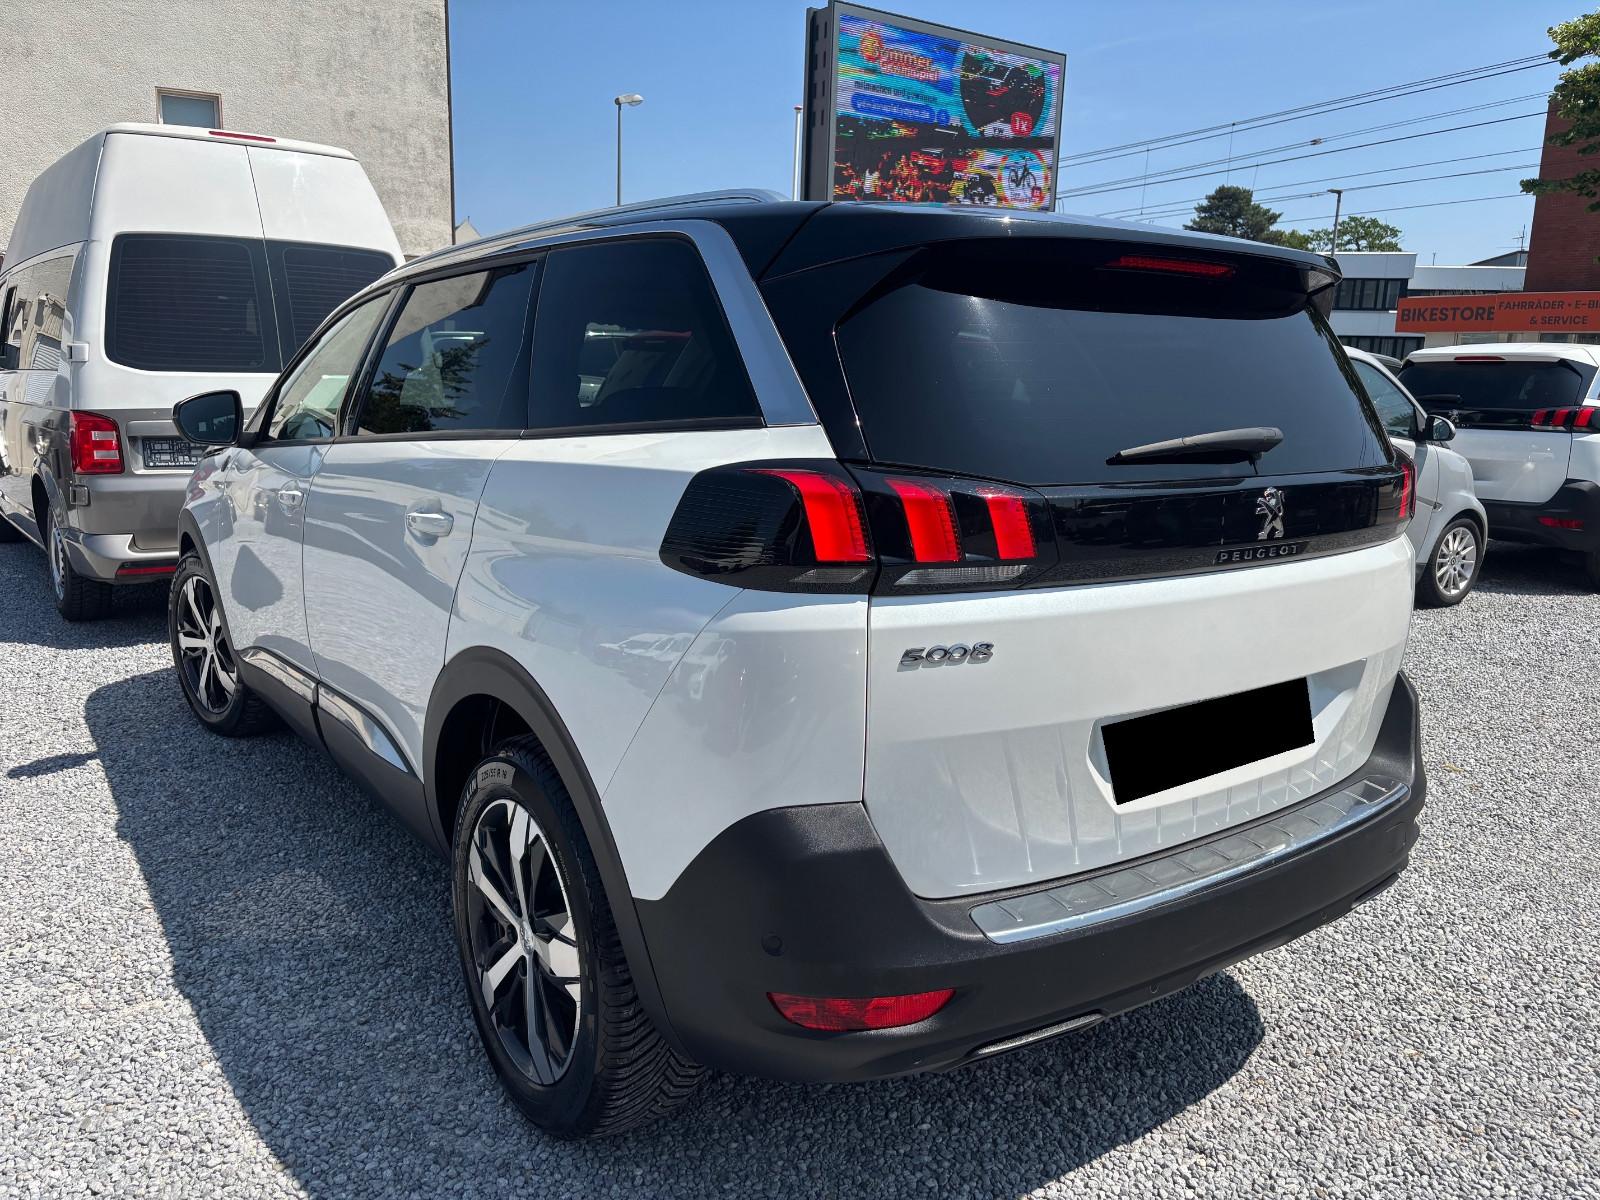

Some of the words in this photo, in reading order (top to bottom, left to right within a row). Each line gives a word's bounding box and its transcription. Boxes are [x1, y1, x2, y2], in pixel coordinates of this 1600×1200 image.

[1499, 299, 1564, 311] FAHRRÄDER
[1575, 299, 1600, 309] E-BI
[1400, 306, 1495, 323] BIKESTORE
[1529, 317, 1537, 325] &
[1541, 315, 1589, 326] SERVICE
[1218, 544, 1298, 563] PEUGEOT
[897, 641, 996, 673] 5008
